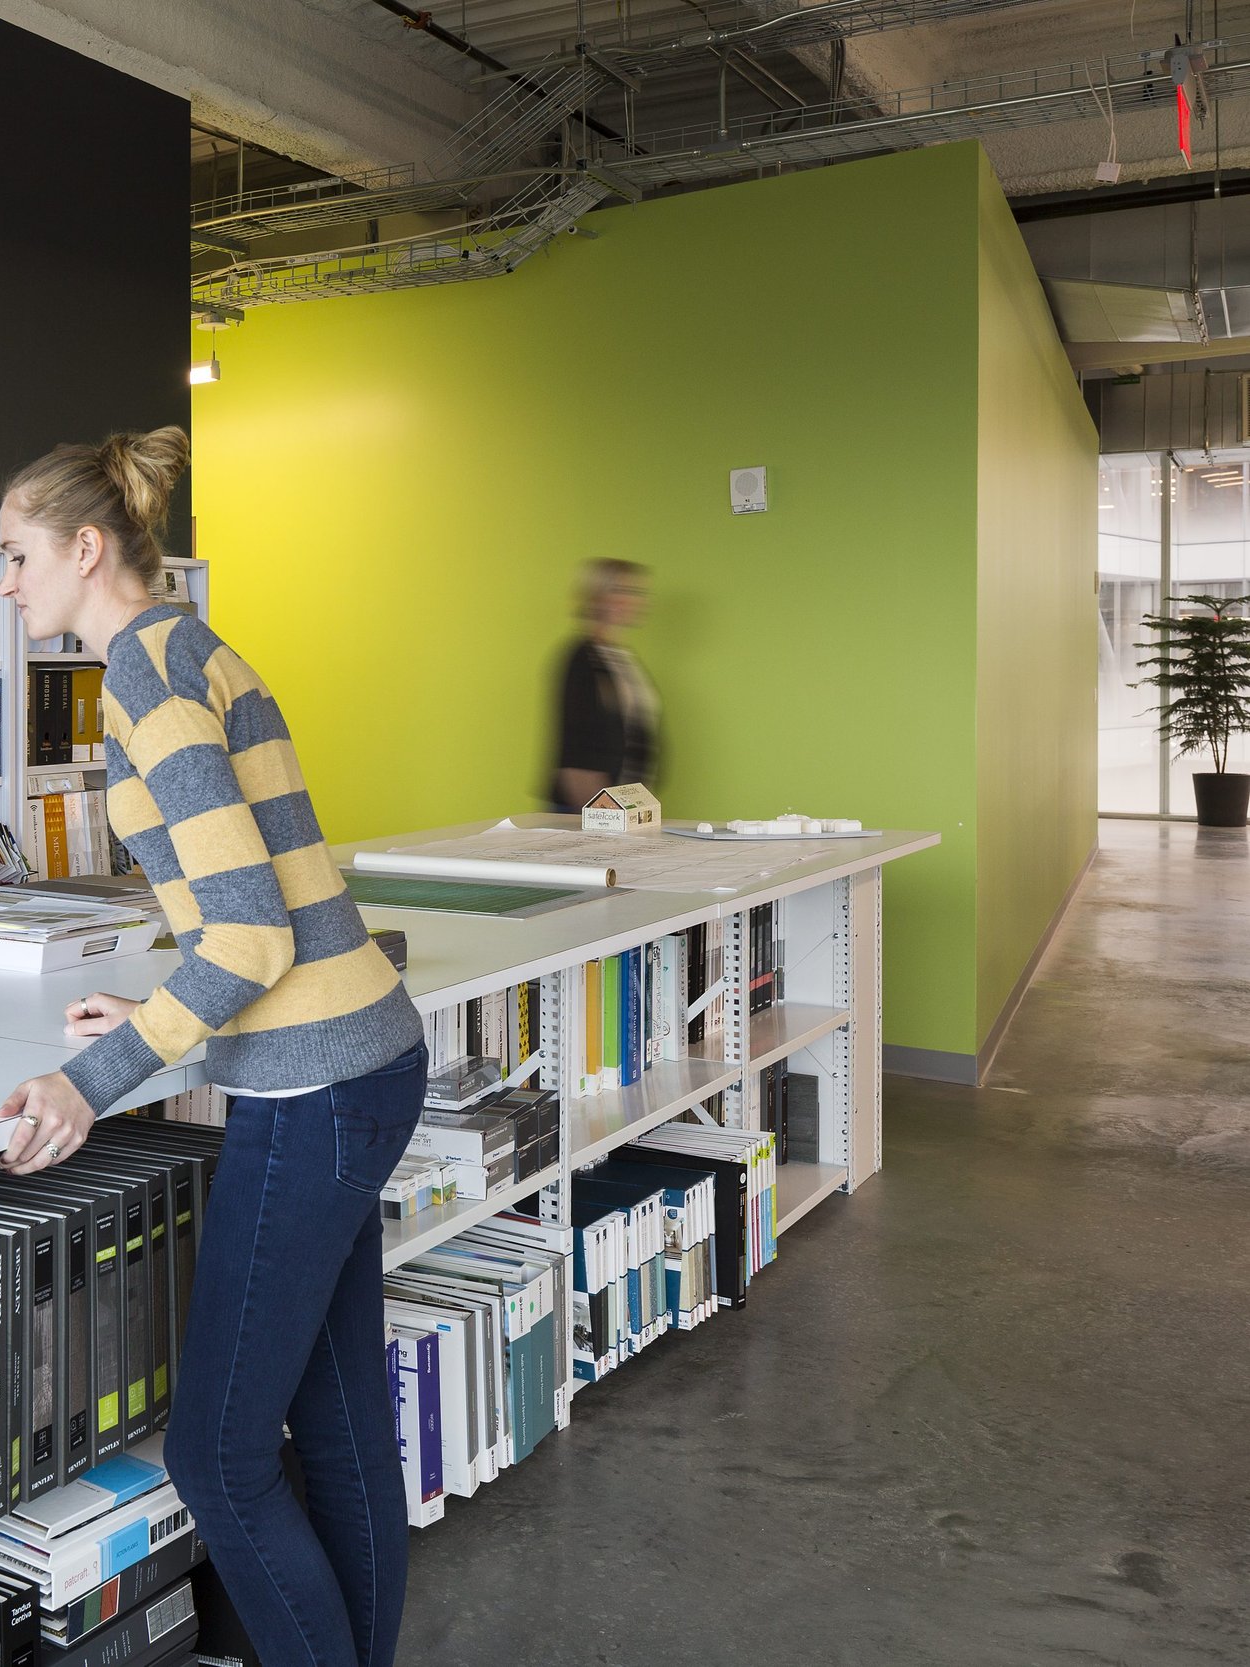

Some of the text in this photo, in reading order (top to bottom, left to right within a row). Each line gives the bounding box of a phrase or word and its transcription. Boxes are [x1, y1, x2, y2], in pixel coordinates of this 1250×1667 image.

[53, 836, 61, 860] MDC
[127, 1424, 148, 1440] BENTLEY
[98, 1439, 120, 1456] BENTLEY
[68, 1455, 88, 1474] BENTLEY
[31, 1472, 55, 1491] BENTLEY
[11, 1600, 32, 1618] Tandus
[11, 1609, 32, 1627] Centiva
